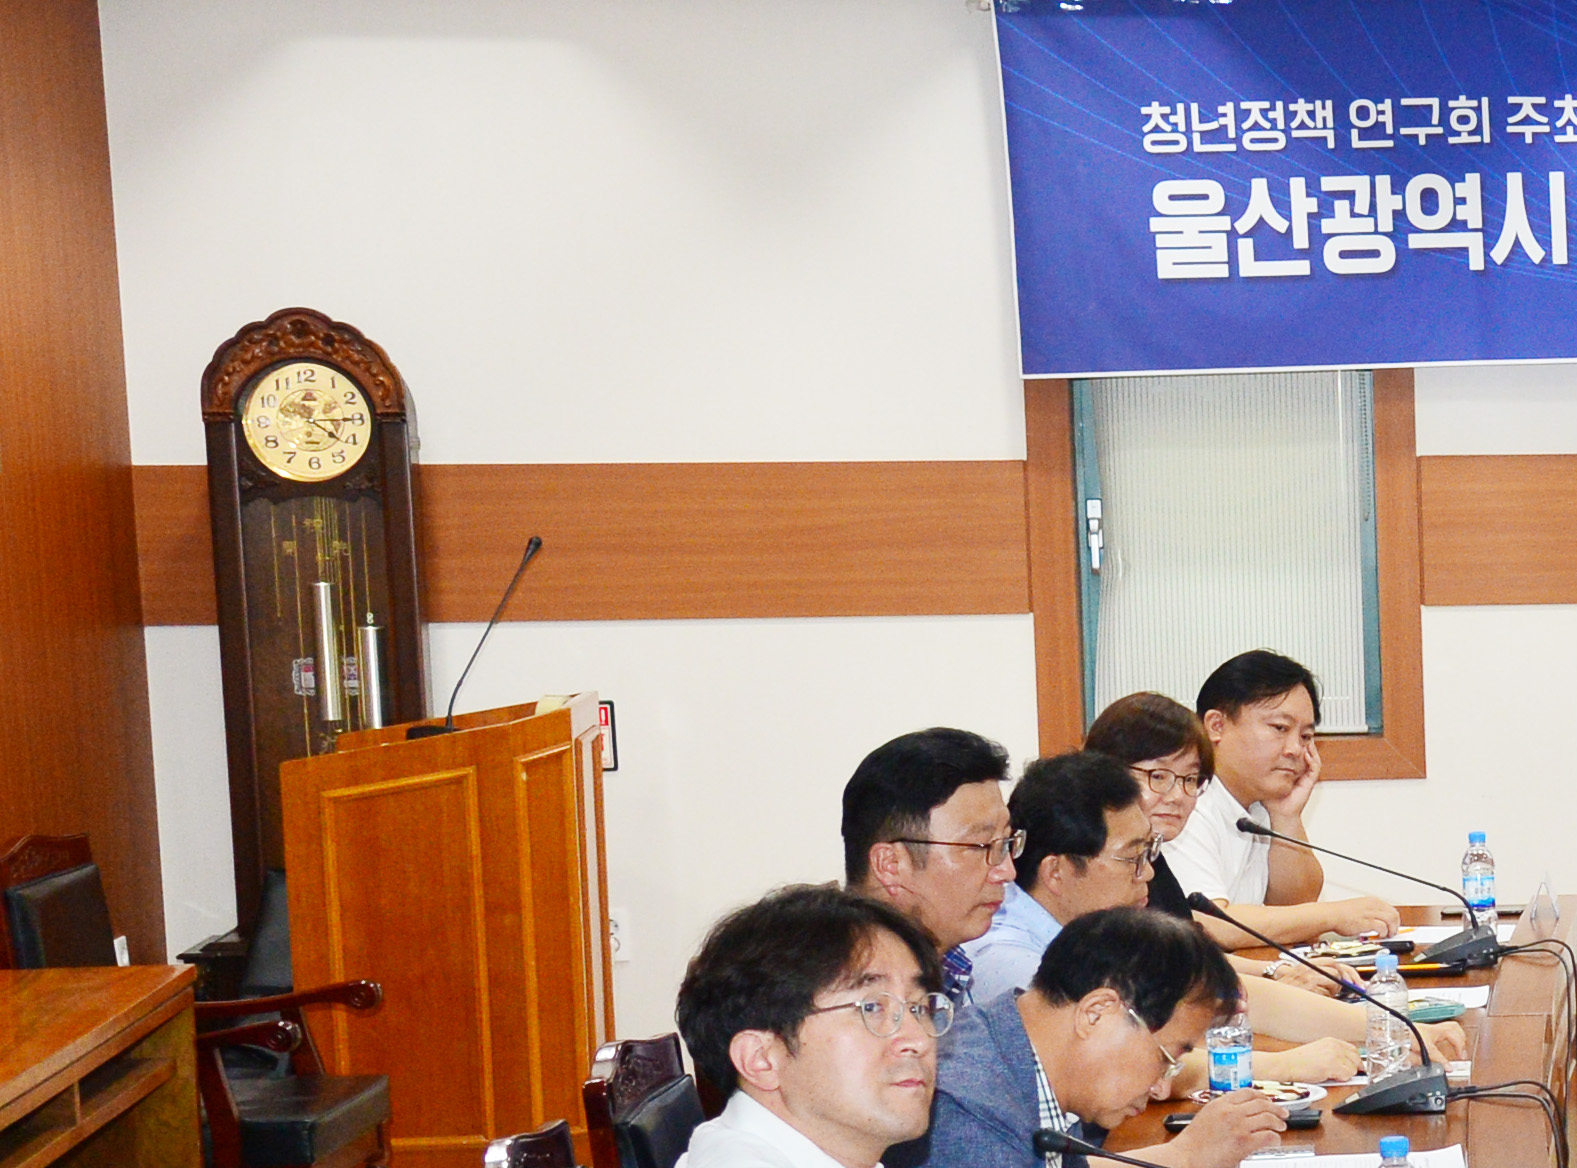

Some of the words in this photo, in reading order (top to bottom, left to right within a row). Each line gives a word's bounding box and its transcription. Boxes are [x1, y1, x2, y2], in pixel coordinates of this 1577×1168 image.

[1140, 98, 1335, 154] 청년정책
[1349, 95, 1491, 149] 연구회
[1149, 171, 1569, 280] 울산광역시
[296, 368, 316, 384] 12
[275, 376, 290, 391] 11
[260, 394, 277, 408] 10
[343, 391, 357, 405] 2
[256, 415, 270, 429] 9
[264, 435, 279, 449] 8
[344, 433, 358, 446] 4
[283, 451, 297, 464] 7
[308, 456, 322, 470] 6
[331, 450, 346, 464] 5
